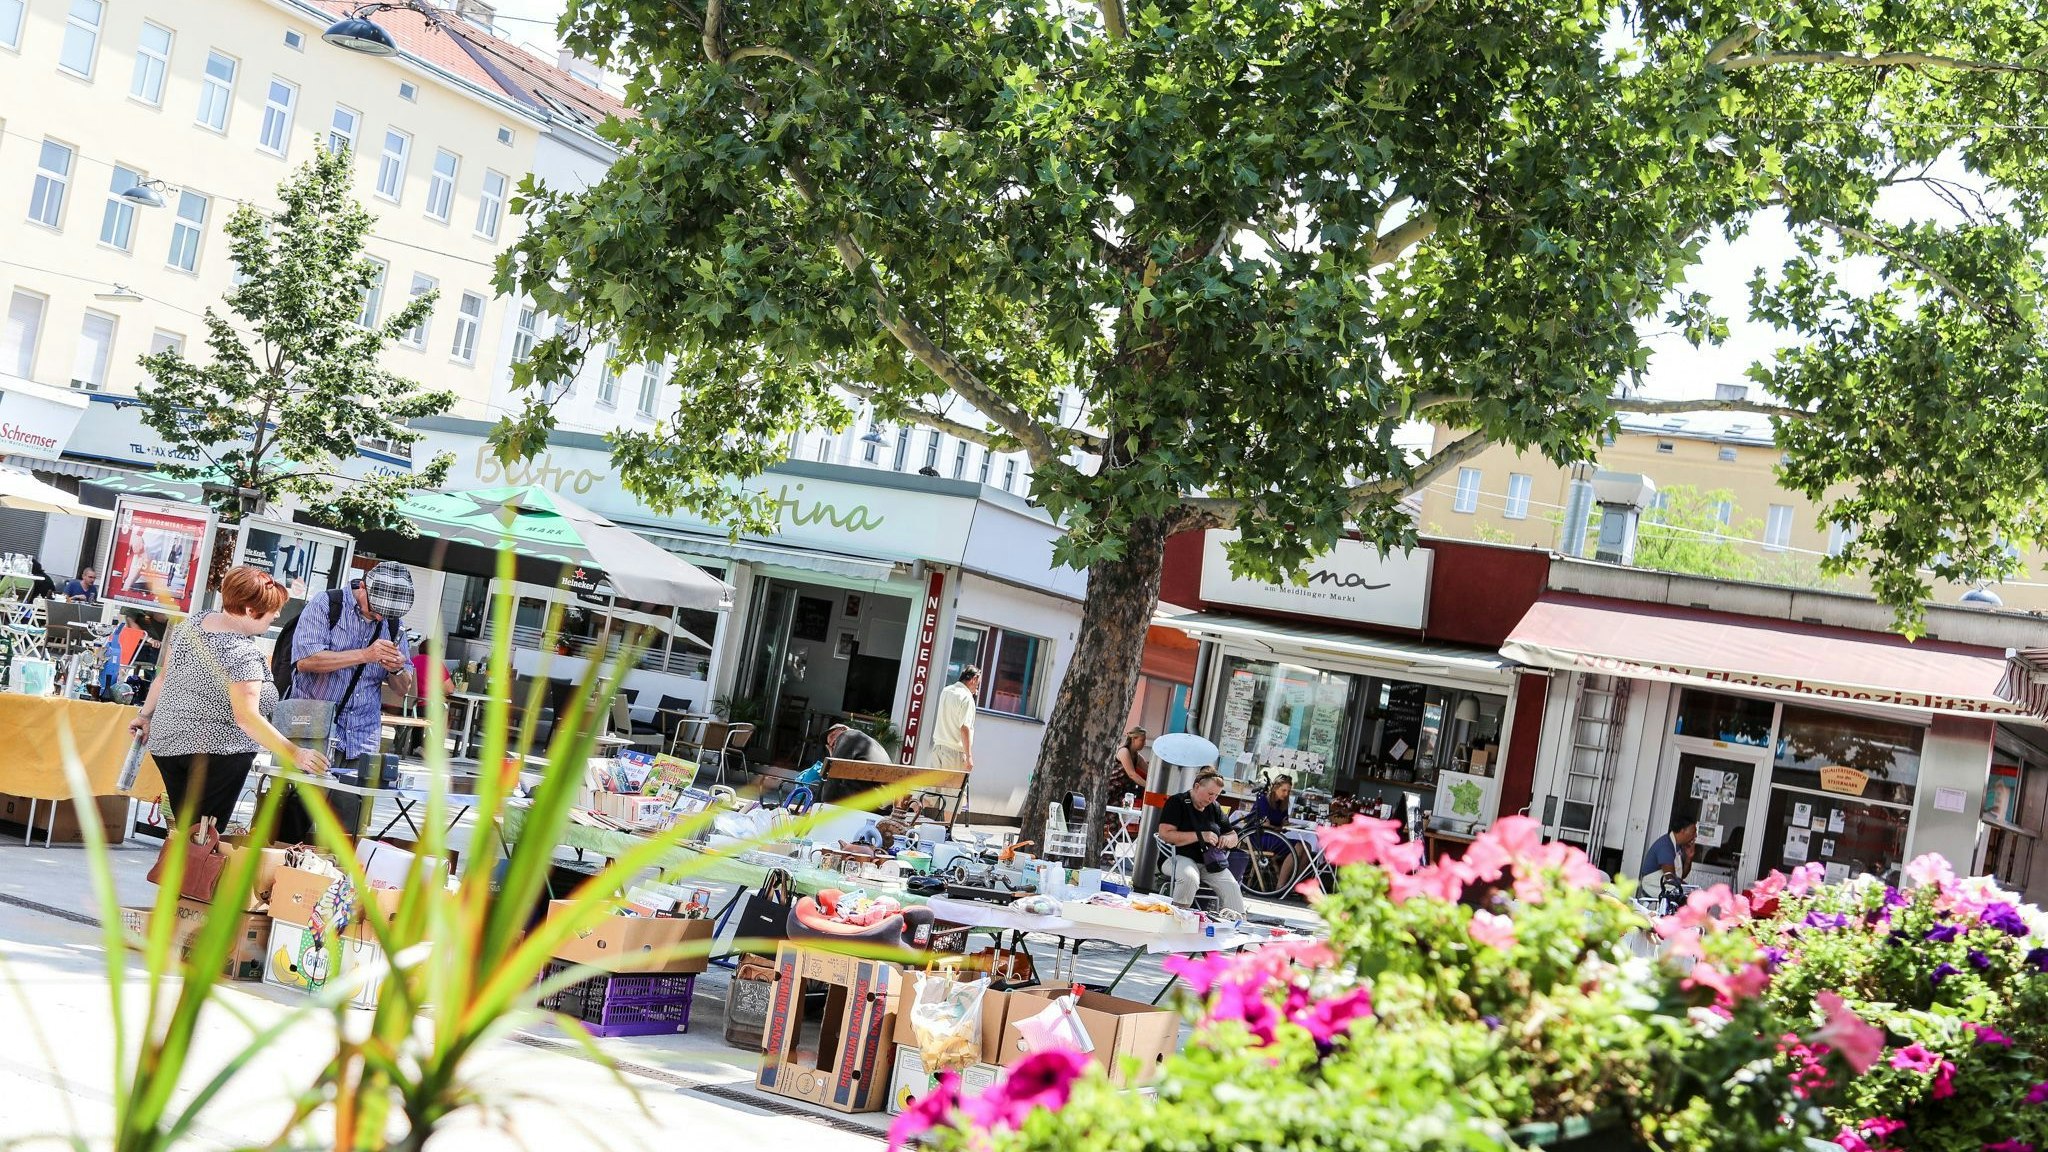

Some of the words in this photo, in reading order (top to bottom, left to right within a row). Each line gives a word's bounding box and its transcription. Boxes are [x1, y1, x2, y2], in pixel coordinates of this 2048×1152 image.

[0, 422, 57, 449] Schremser
[130, 443, 144, 454] TEL
[475, 442, 605, 495] Bistro
[526, 525, 564, 536] MARK
[561, 576, 595, 590] Heineken
[1279, 586, 1327, 599] Meidlinger
[1329, 592, 1356, 602] Markt
[775, 963, 793, 1015] PREMIUM
[840, 1035, 858, 1088] PREMIUM
[851, 979, 869, 1035] BANANAS
